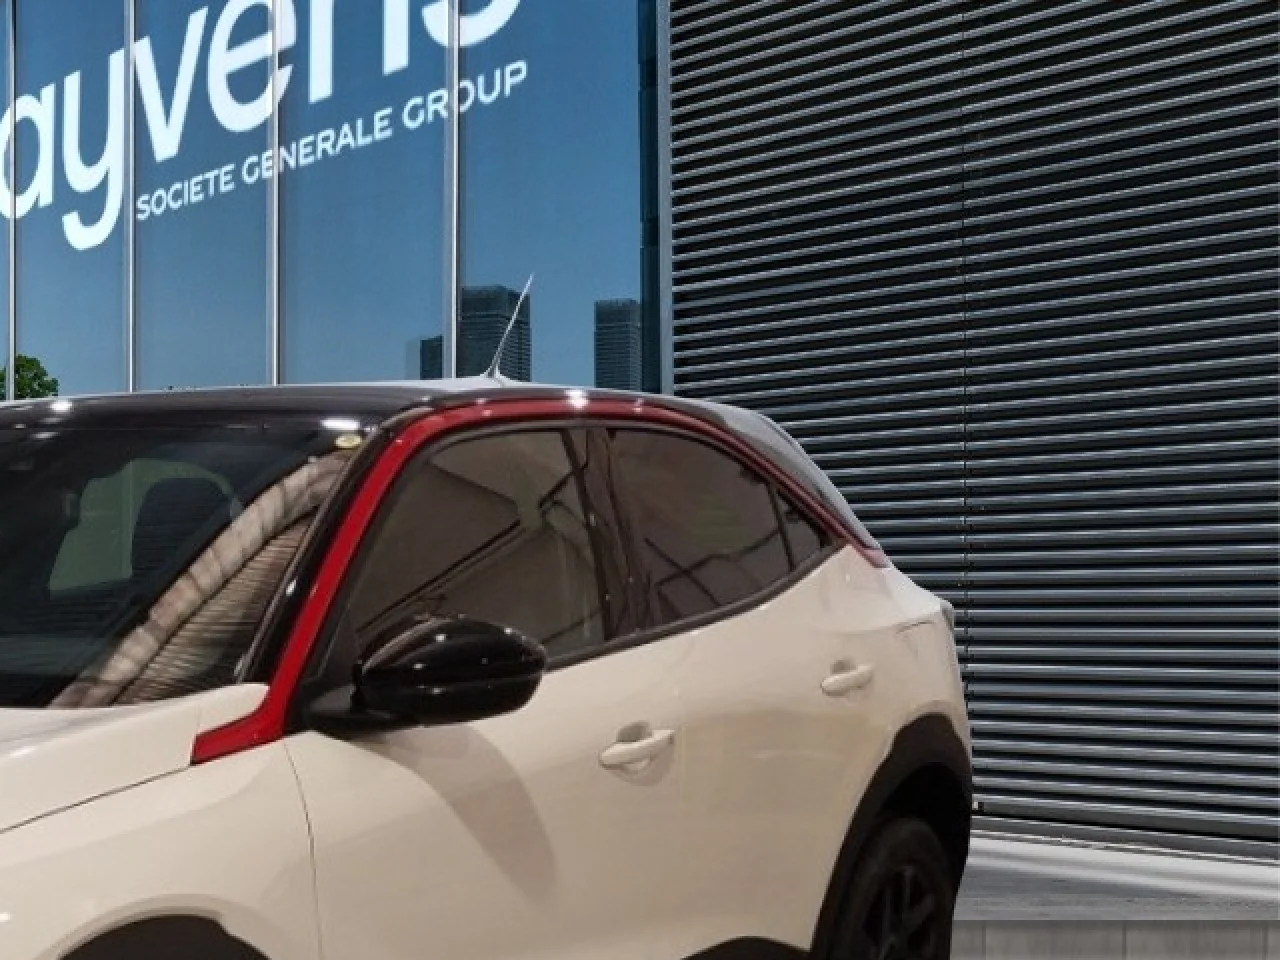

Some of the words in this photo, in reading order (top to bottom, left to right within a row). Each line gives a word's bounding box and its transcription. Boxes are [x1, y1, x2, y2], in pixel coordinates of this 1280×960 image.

[135, 165, 235, 221] SOCIETE
[242, 107, 394, 184] GENERALE
[402, 60, 528, 131] GROUP
